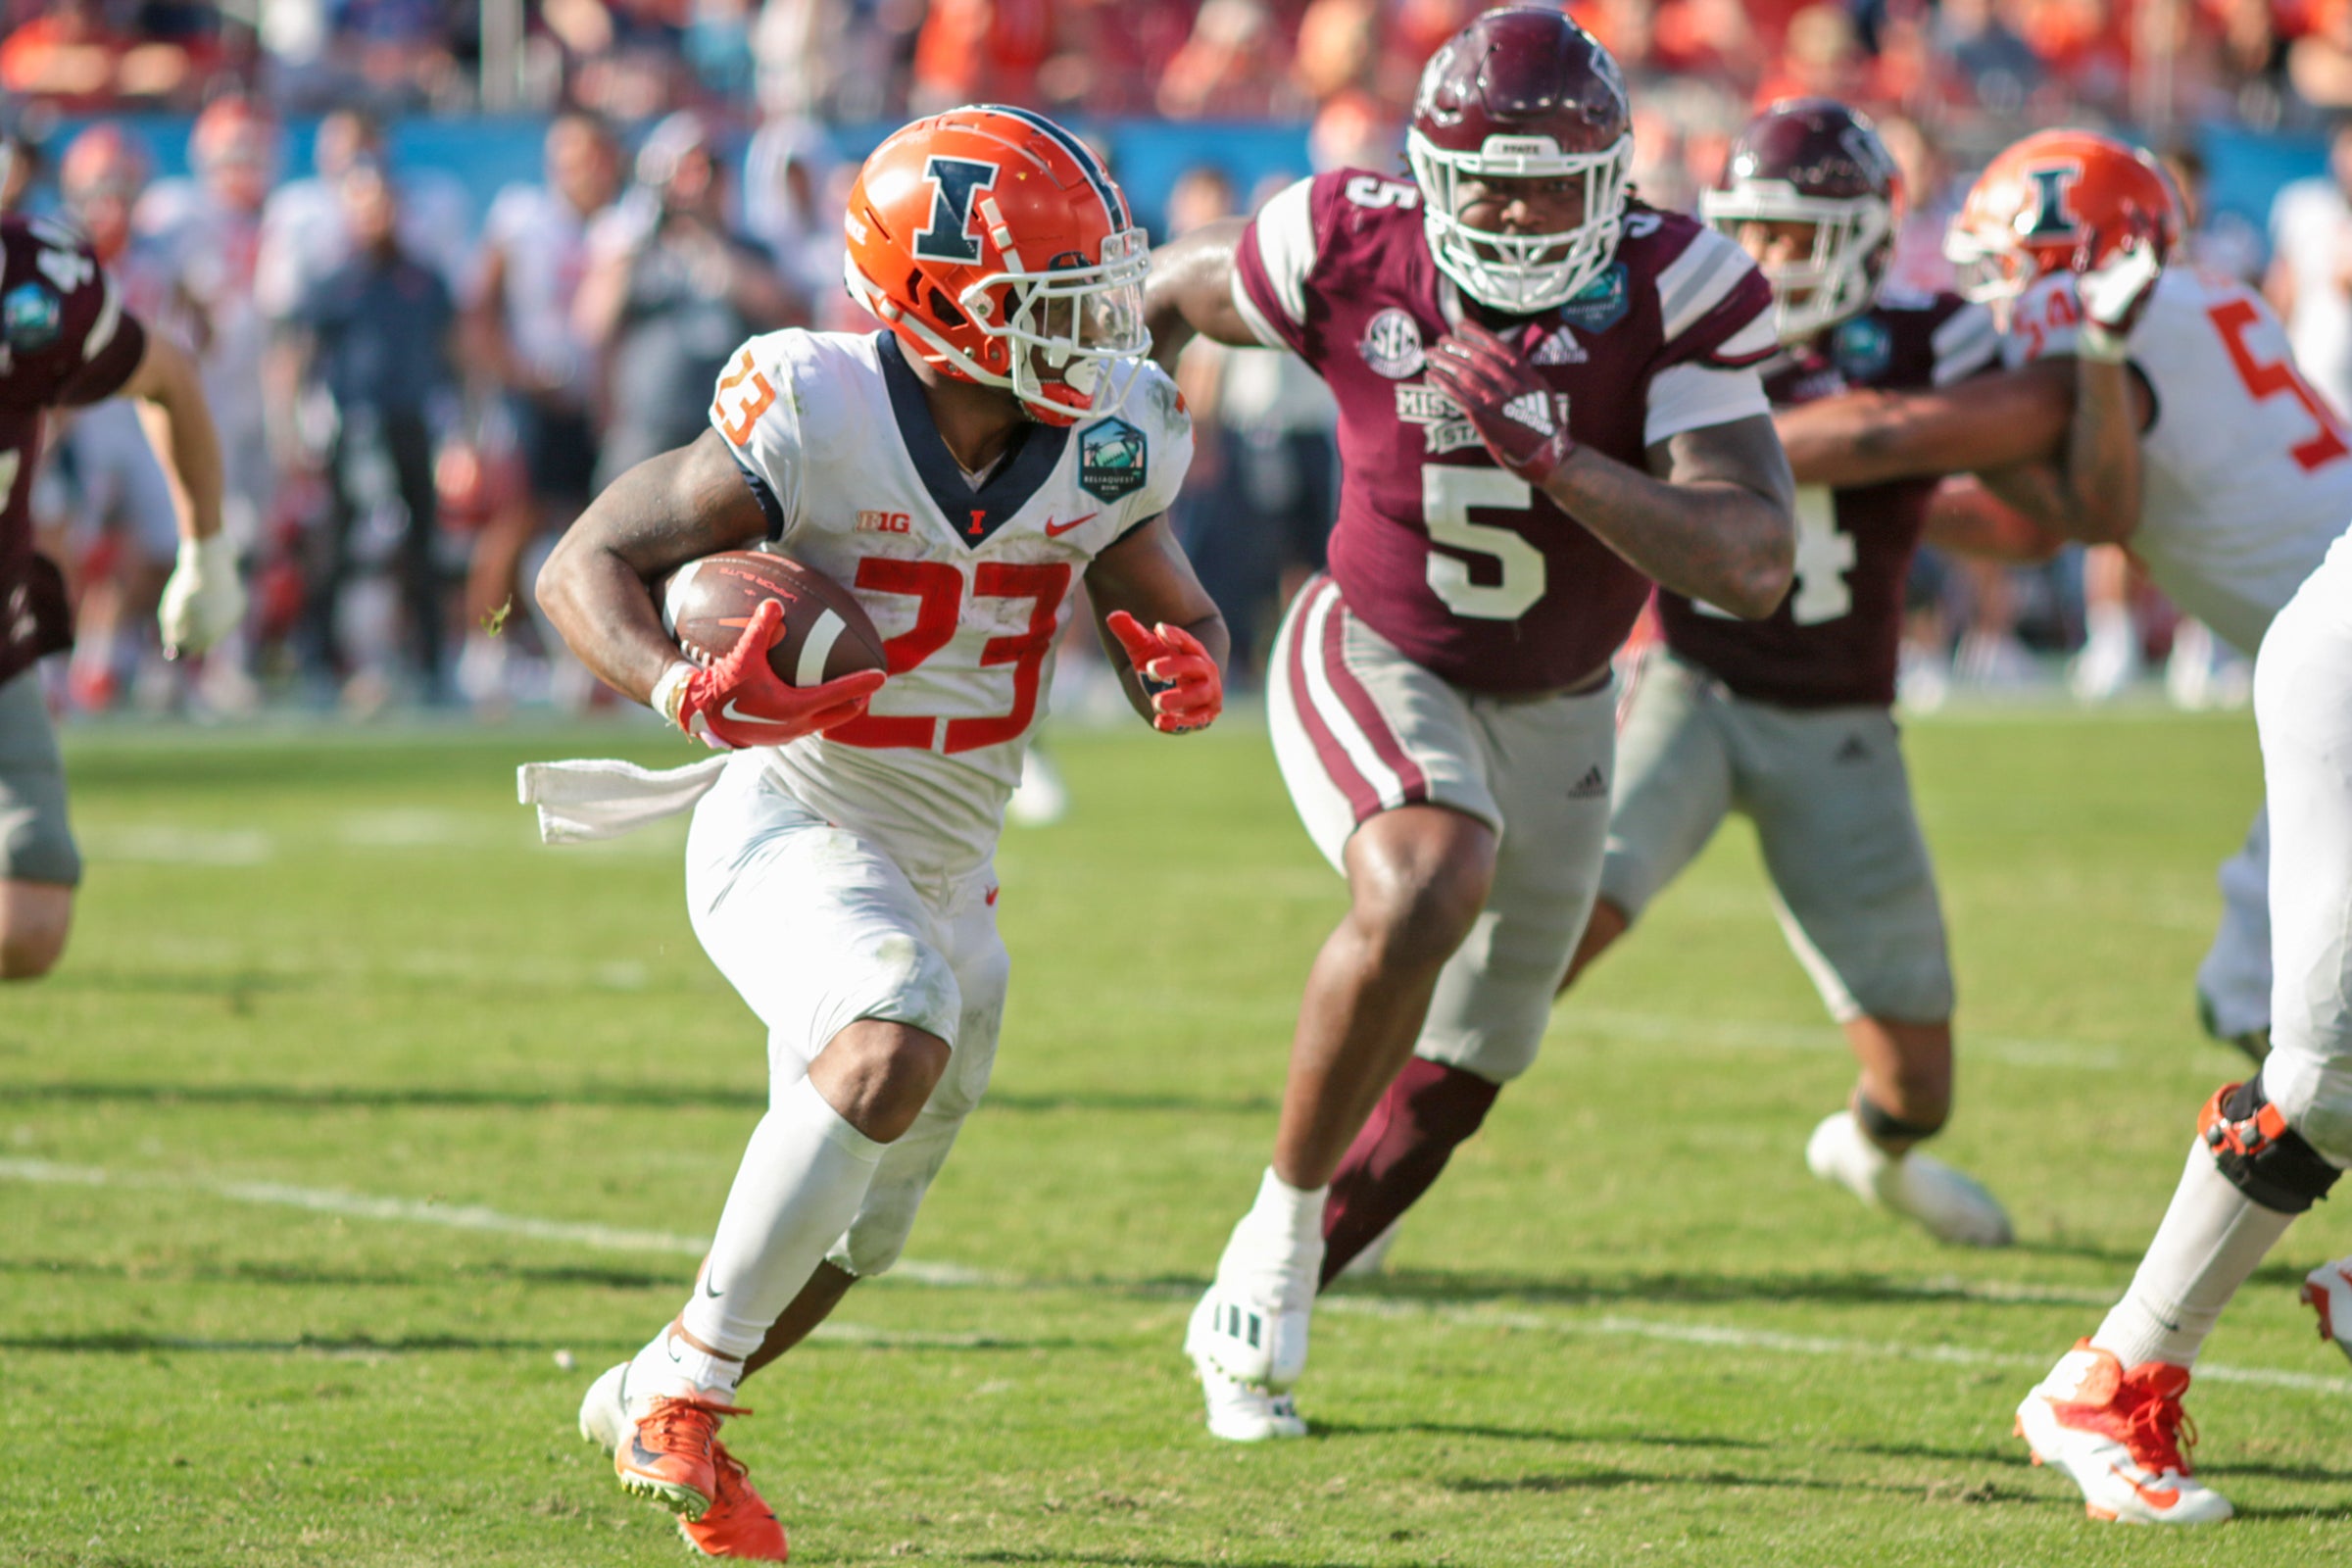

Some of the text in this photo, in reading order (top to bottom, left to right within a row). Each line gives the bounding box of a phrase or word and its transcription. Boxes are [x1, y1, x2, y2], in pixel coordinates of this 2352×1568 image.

[1346, 175, 1417, 210] 5
[912, 154, 1001, 267] I
[1502, 401, 1556, 436] adidas
[1084, 475, 1135, 484] RELIAQUEST
[967, 510, 987, 535] I
[1421, 463, 1547, 620] 5
[821, 557, 1072, 756] 23
